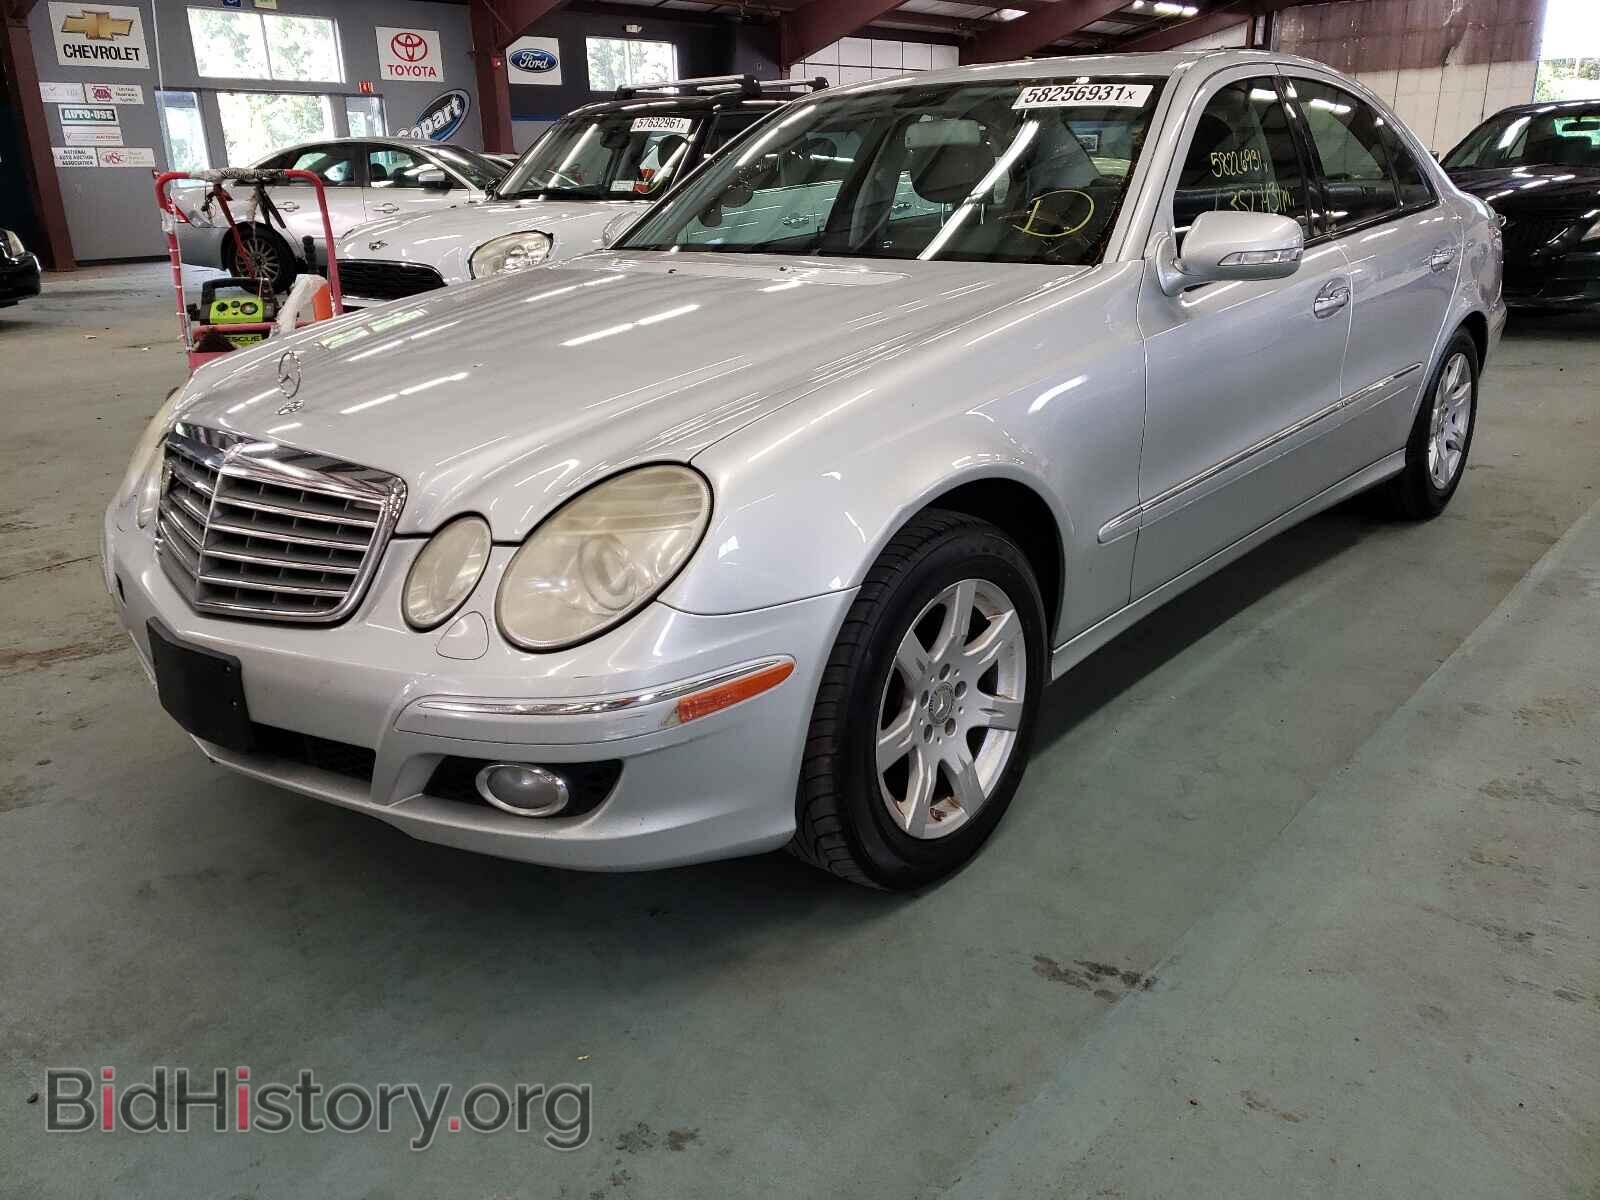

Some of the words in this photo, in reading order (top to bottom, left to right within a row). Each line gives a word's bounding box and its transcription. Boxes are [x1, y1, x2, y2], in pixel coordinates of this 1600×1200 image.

[63, 44, 140, 61] CHEVROLET
[519, 51, 549, 69] Ford
[387, 64, 437, 78] TOYOTA
[1024, 85, 1136, 104] 58256931x
